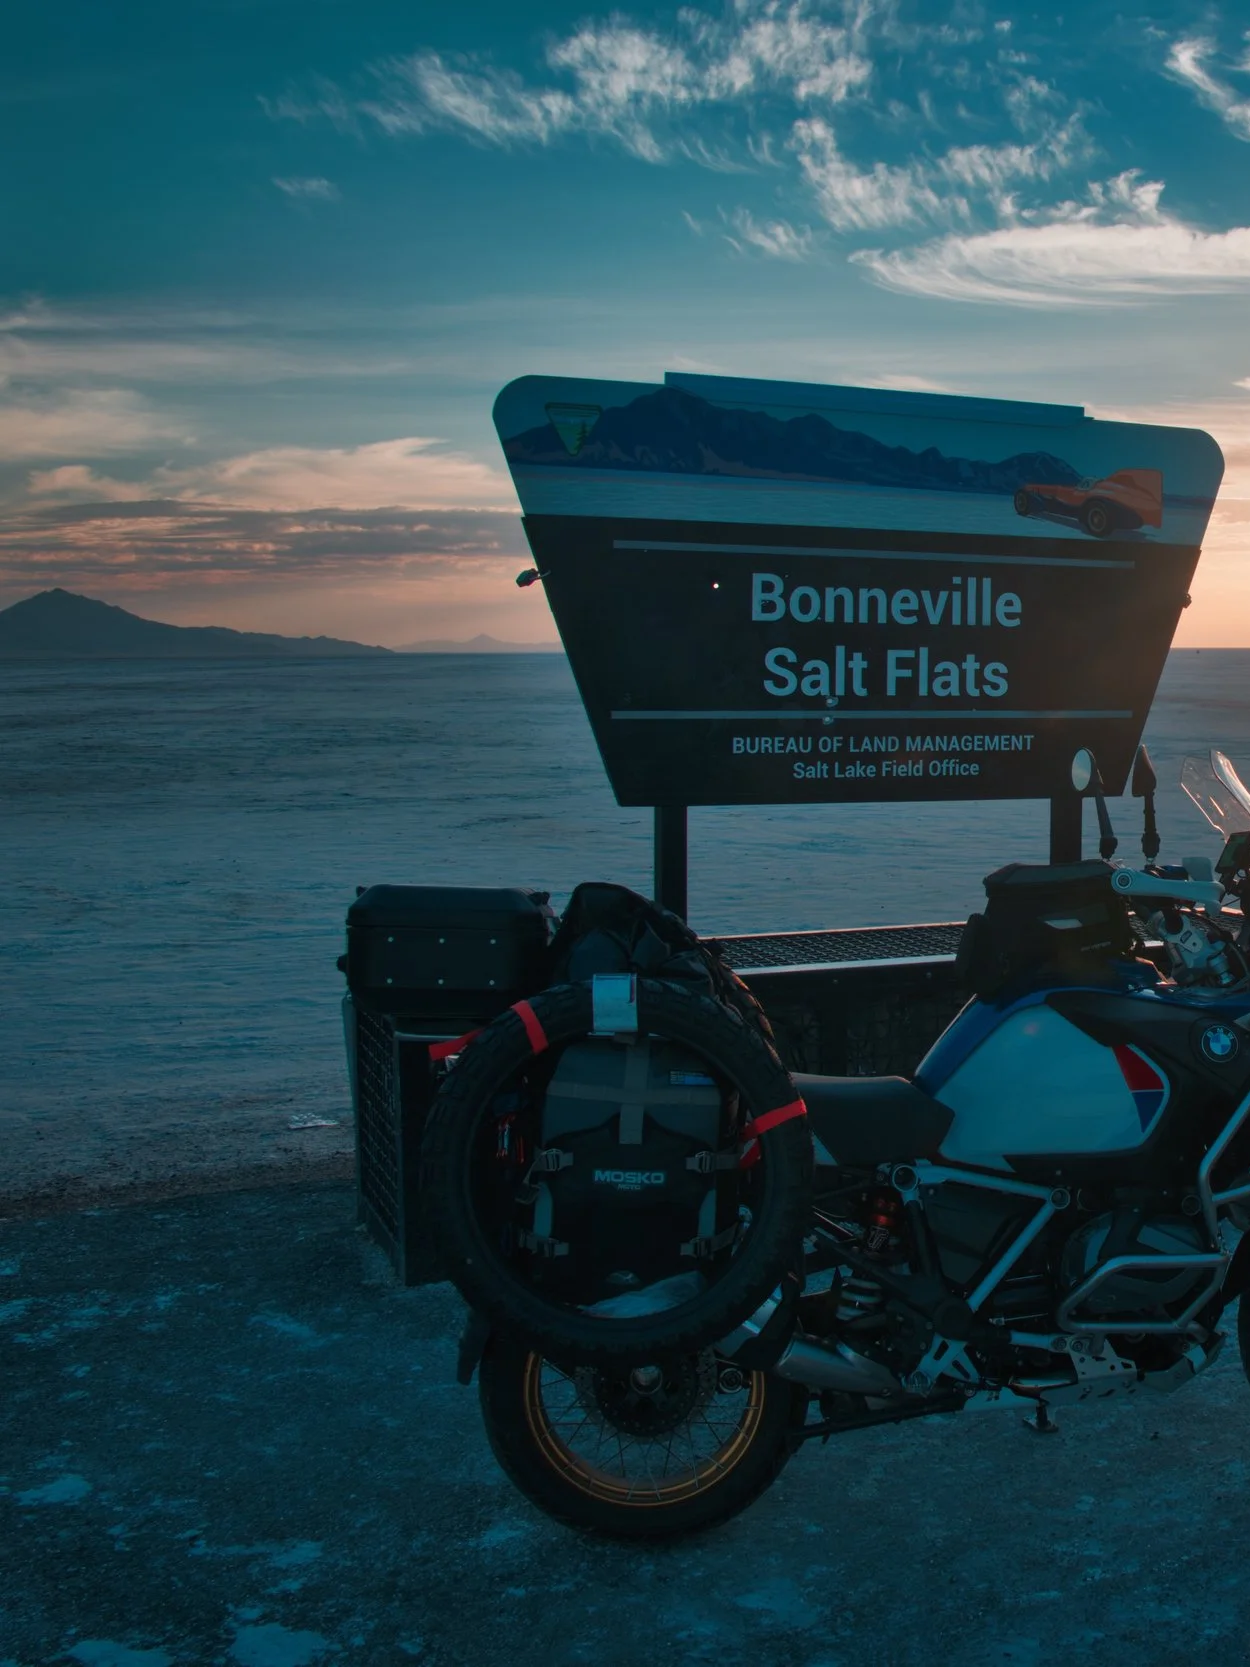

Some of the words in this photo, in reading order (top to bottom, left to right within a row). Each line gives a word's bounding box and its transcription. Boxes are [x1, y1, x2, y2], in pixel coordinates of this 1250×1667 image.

[751, 572, 1023, 627] Bonneville
[763, 645, 868, 698] Salt
[886, 646, 1009, 698] Flats
[732, 736, 812, 754] BUREAU
[818, 736, 844, 753] OF
[849, 735, 900, 753] LAND
[905, 734, 1035, 752] MANAGEMENT
[792, 760, 829, 779] Salt
[834, 760, 877, 778] Lake
[881, 759, 924, 777] Field
[928, 758, 980, 777] Office
[594, 1170, 665, 1184] MOSKO
